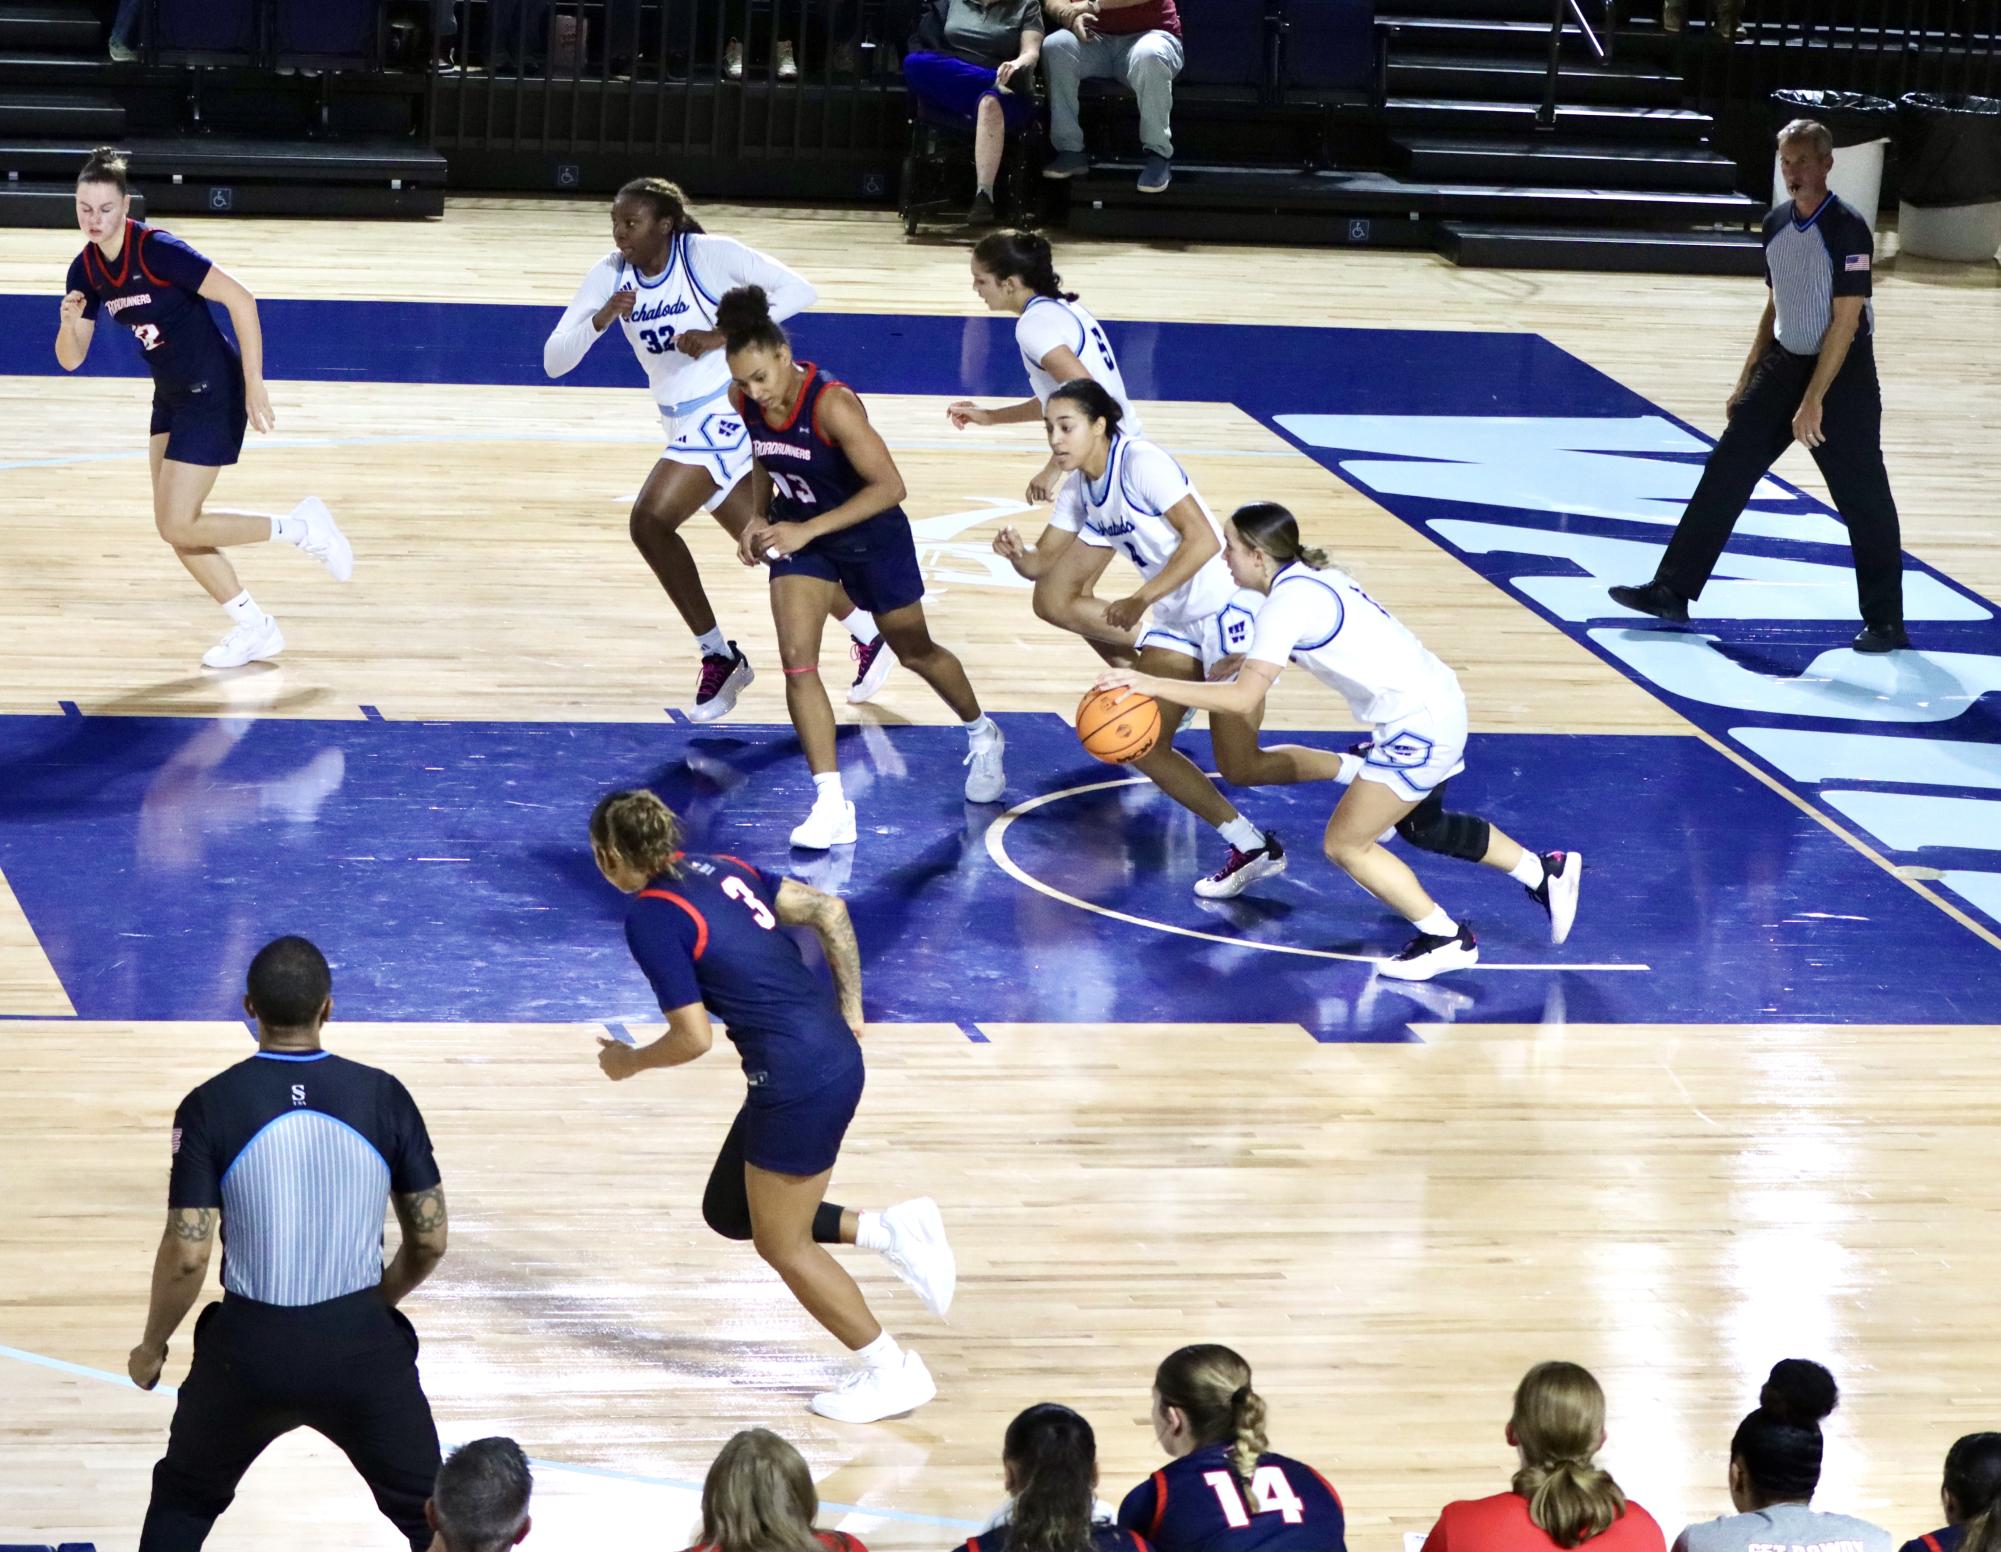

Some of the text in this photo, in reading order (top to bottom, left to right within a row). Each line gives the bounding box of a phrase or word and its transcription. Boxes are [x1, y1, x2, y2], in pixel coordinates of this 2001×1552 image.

[624, 294, 690, 323] chabods
[131, 323, 165, 352] 2
[640, 325, 676, 355] 32
[1090, 326, 1115, 371] 5
[753, 439, 811, 461] ROADRUNNERS
[768, 471, 817, 503] 13
[720, 874, 776, 931] 3
[1203, 1464, 1304, 1528] 14
